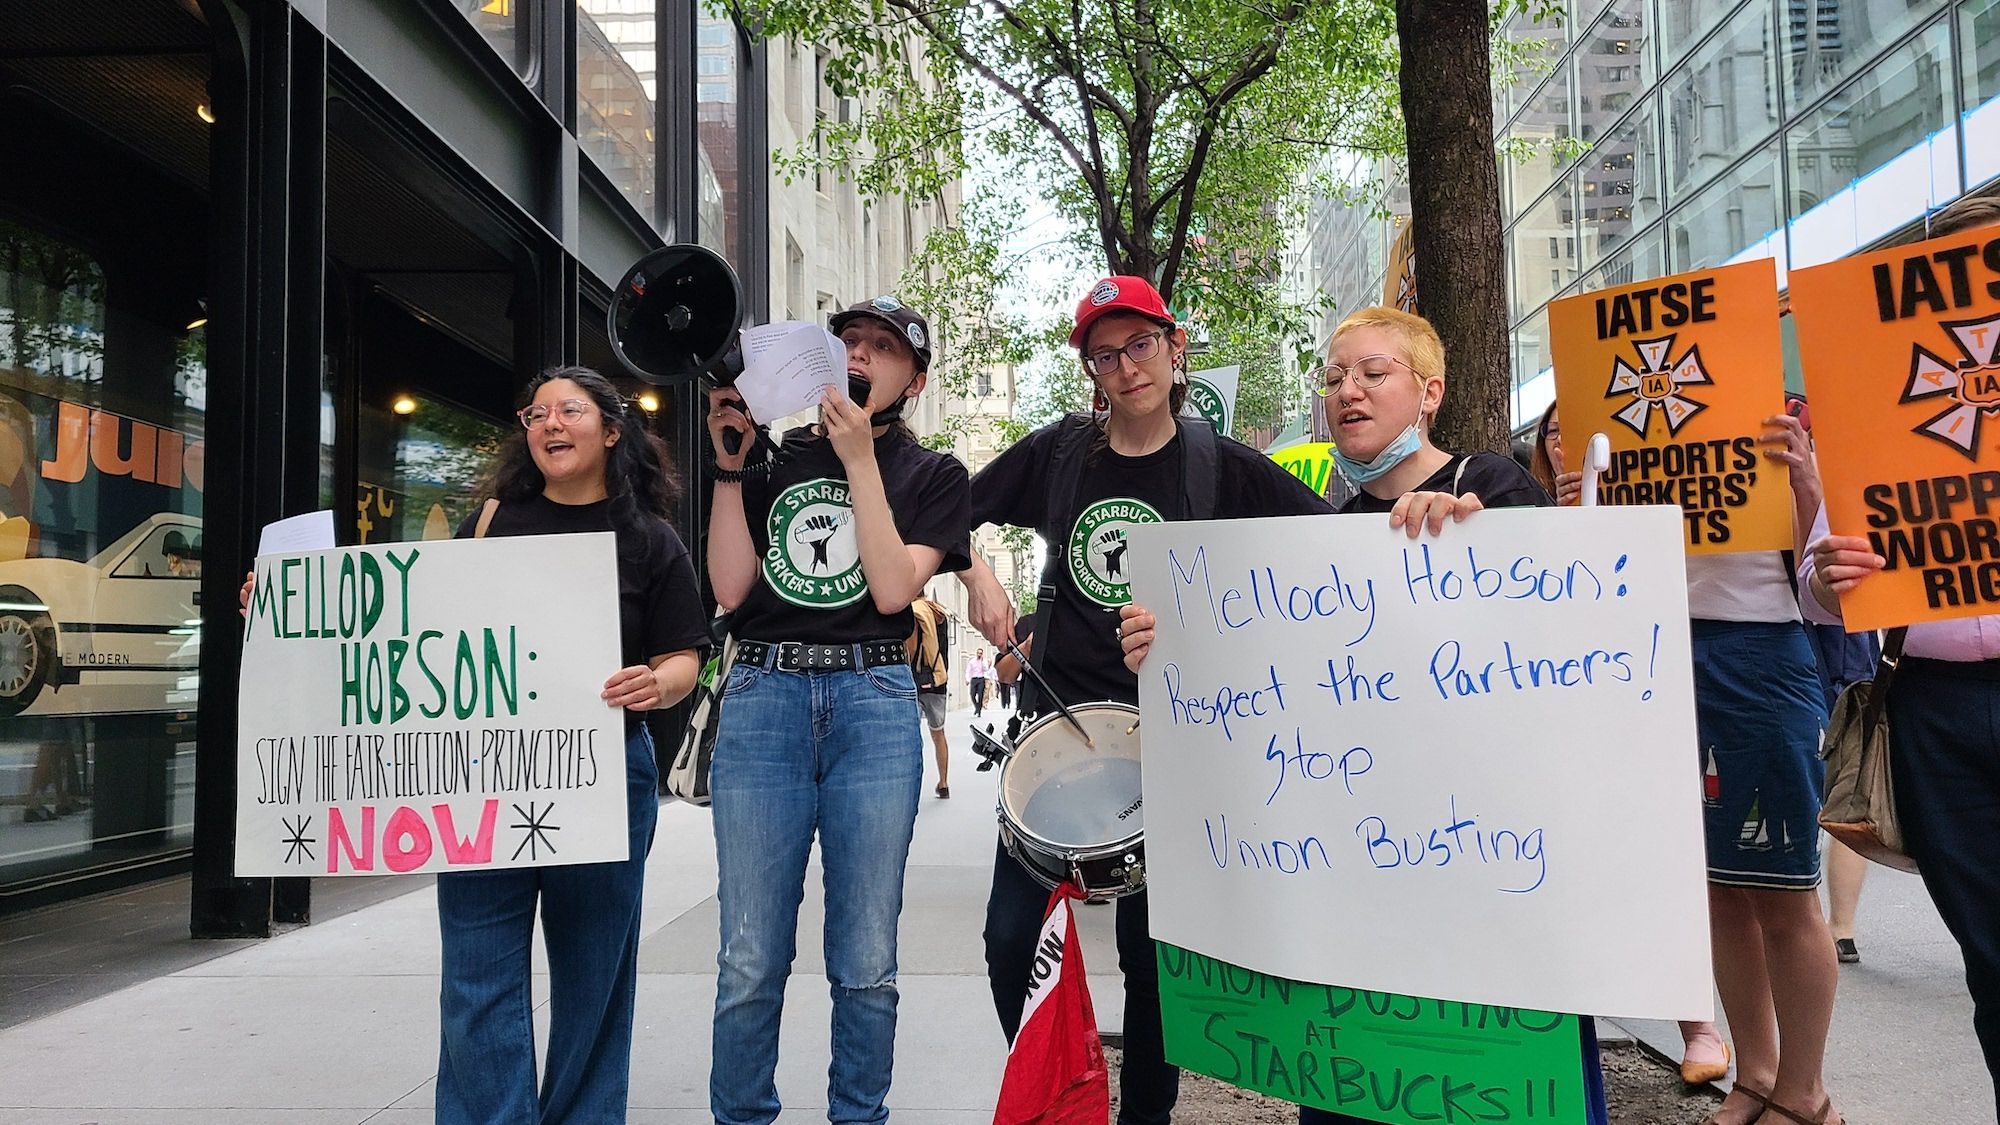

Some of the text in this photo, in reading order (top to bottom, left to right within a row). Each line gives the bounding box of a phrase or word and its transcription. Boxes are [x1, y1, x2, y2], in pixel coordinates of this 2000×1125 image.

[1595, 278, 1716, 340] IATSE
[1598, 437, 1756, 484] UPPORTS
[246, 548, 420, 642] MELLODY
[834, 563, 863, 593] UNI
[1072, 544, 1112, 598] WORKERS
[1167, 543, 1629, 647] Mellody Hobson:
[78, 652, 130, 665] MODERN
[341, 625, 538, 726] HOBSON:
[1164, 623, 1660, 741] Respect the Partners!
[256, 736, 306, 805] SIGN
[313, 734, 339, 802] THE
[1266, 726, 1374, 806] Stop
[327, 799, 500, 874] NOW
[1118, 797, 1143, 821] VANS
[1204, 794, 1546, 894] Union Busting
[1304, 1020, 1342, 1050] AT
